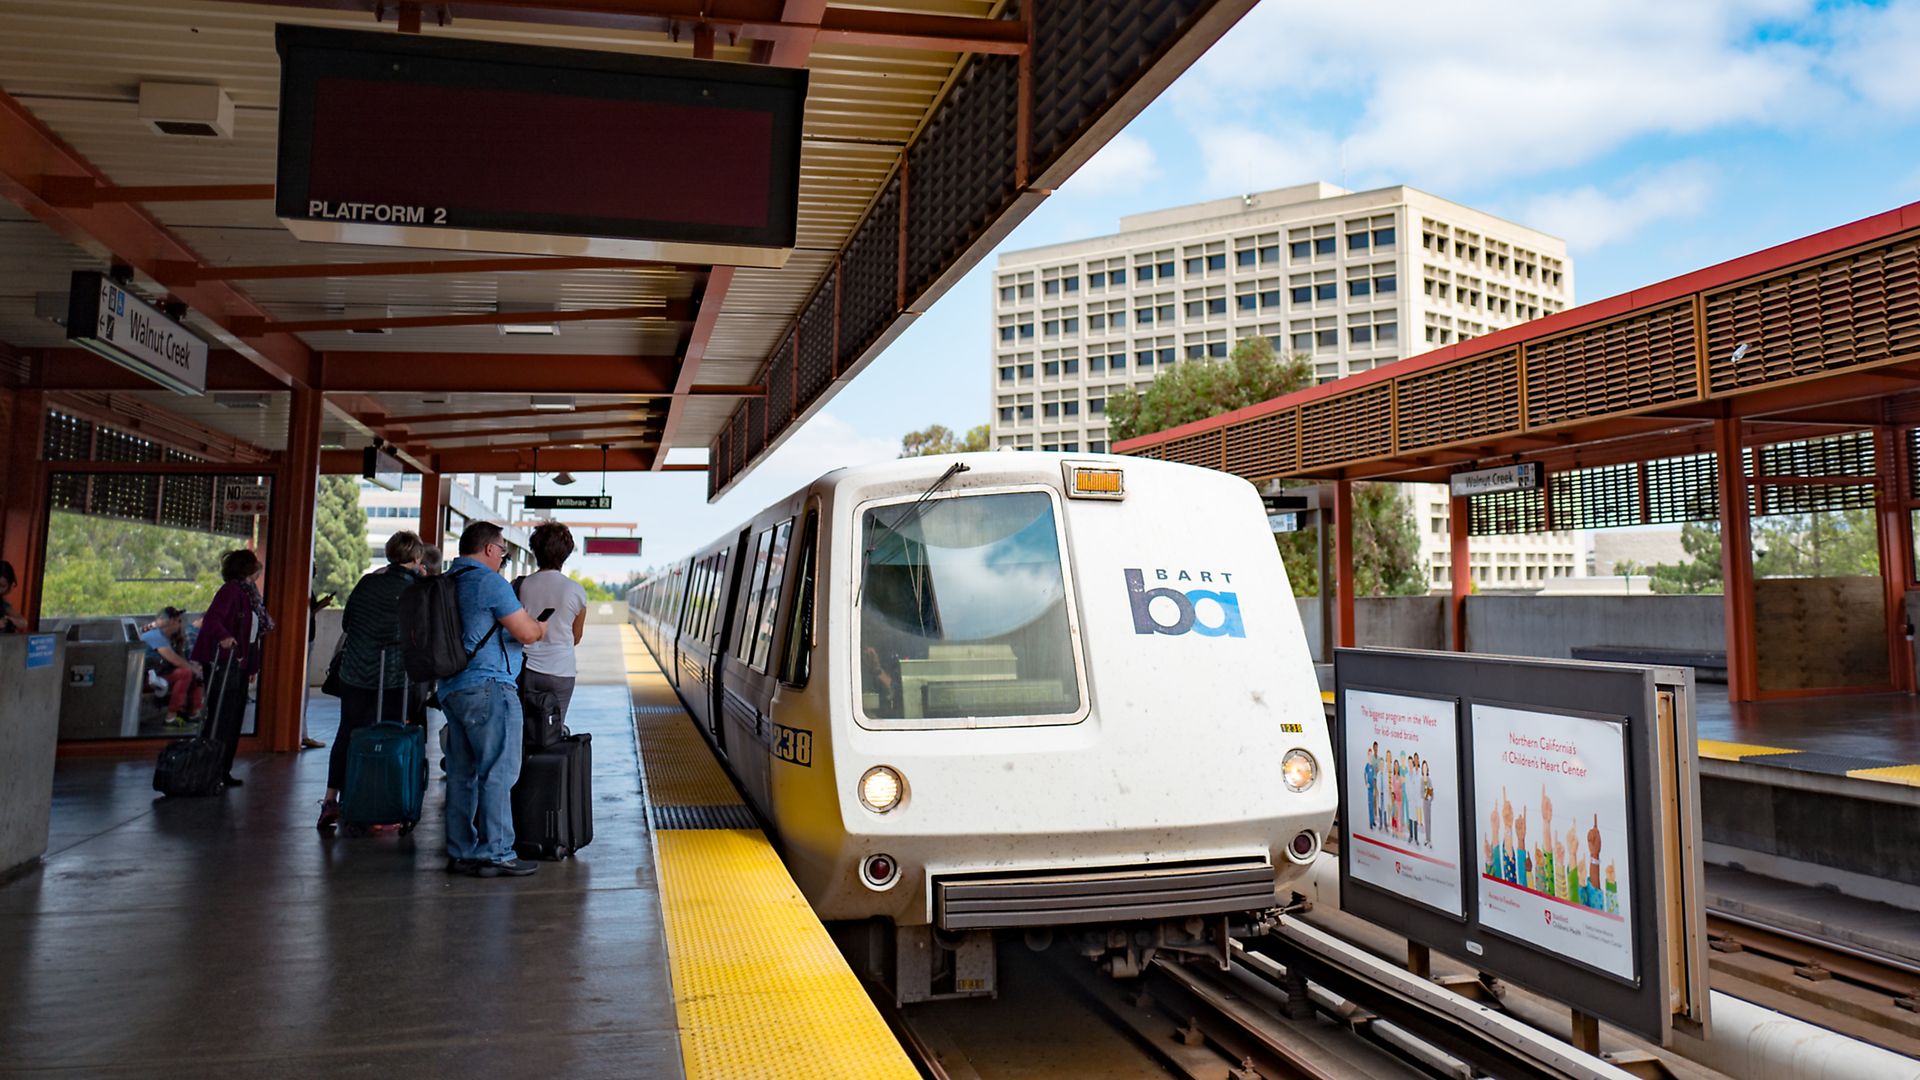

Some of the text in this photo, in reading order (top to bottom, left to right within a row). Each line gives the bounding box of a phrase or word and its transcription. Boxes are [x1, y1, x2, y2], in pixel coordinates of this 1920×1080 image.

[309, 201, 447, 224] PLATFORM 2
[130, 309, 191, 369] Walnut Creek
[1465, 471, 1513, 488] Walnut Creek
[227, 486, 241, 500] NO
[556, 498, 587, 507] Millbrae
[1156, 568, 1232, 584] BART
[1124, 568, 1246, 638] ba
[1369, 709, 1385, 722] biggest
[1386, 713, 1406, 725] program
[1413, 715, 1421, 725] the
[1423, 715, 1438, 727] West
[1382, 726, 1403, 740] kid-sized
[1404, 729, 1419, 742] brains
[1509, 731, 1577, 755] Northern California's
[1508, 751, 1539, 769] Children's
[1540, 758, 1560, 774] Heart
[1562, 760, 1588, 777] Center
